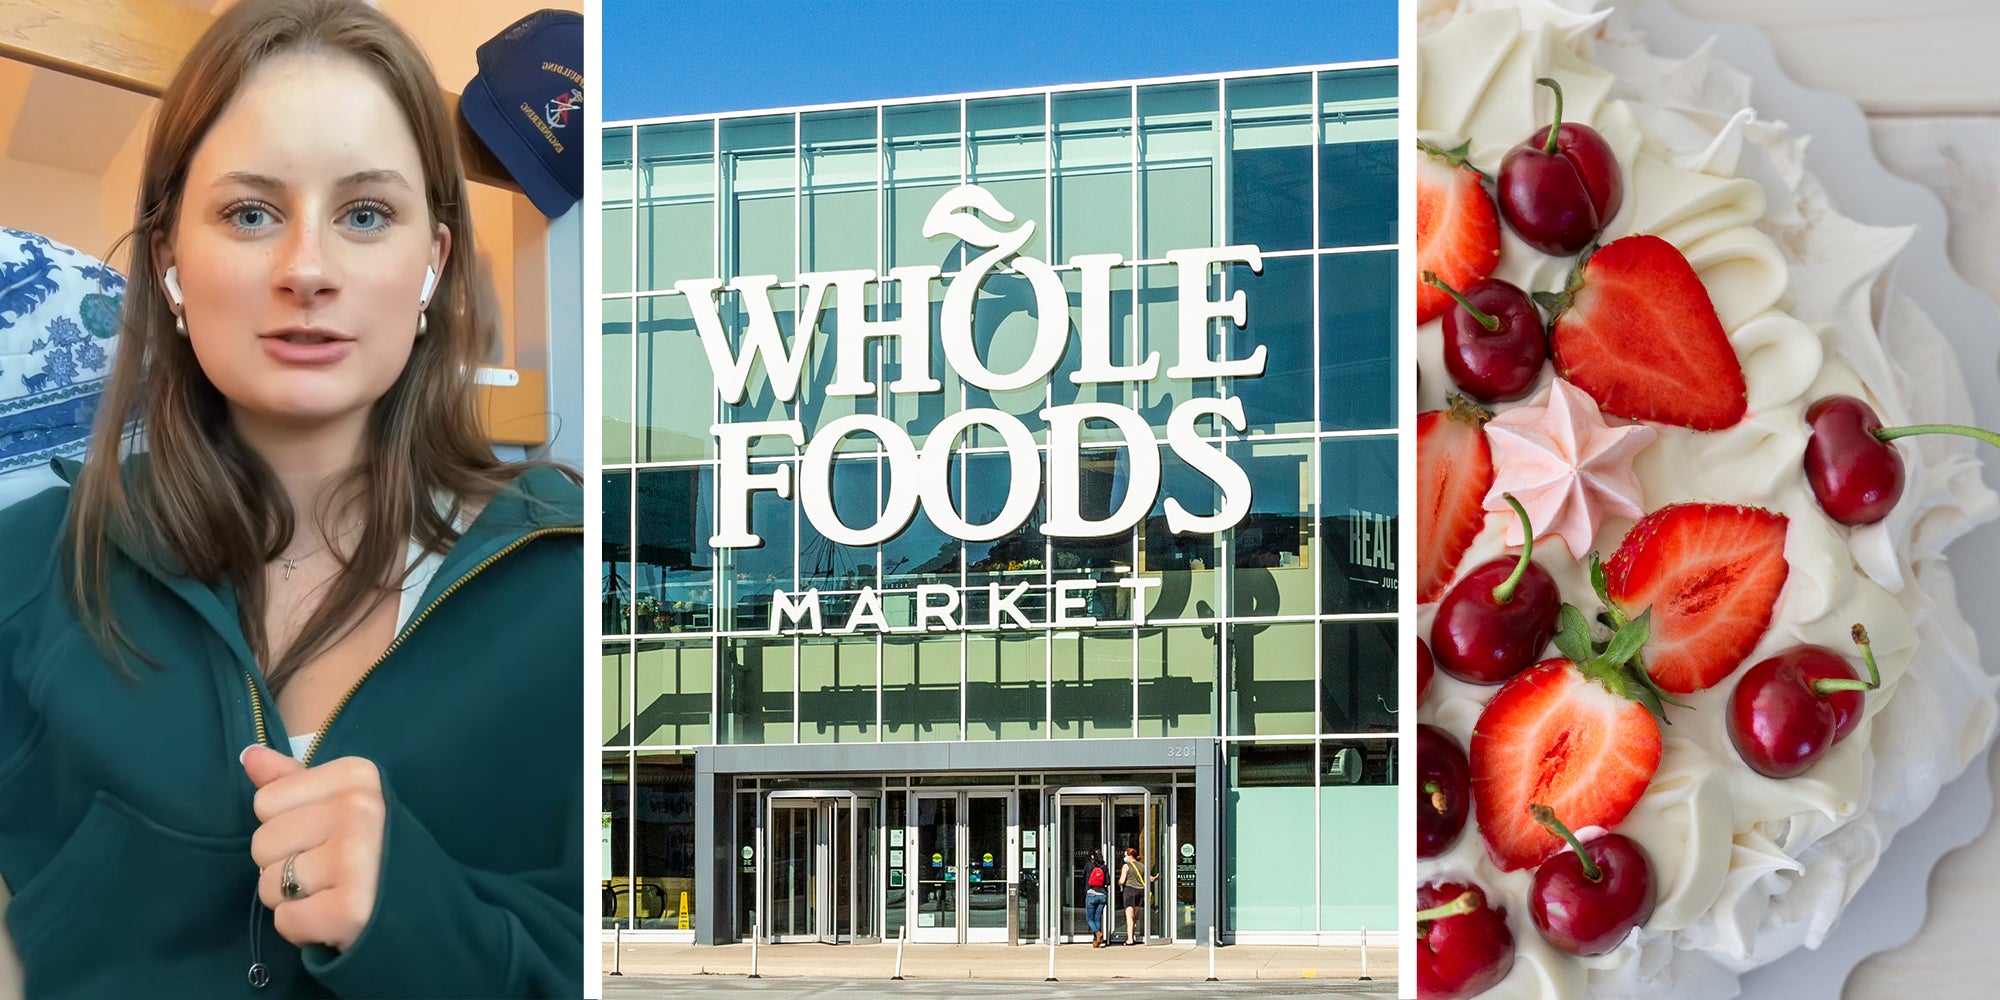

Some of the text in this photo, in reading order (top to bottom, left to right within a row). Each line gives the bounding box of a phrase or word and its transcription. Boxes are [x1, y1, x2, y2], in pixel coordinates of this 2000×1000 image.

[675, 243, 1267, 404] WHOLE
[709, 396, 1252, 548] FOODS
[1349, 508, 1395, 571] REAL
[770, 577, 1162, 635] MARKET
[1167, 746, 1196, 757] 3201
